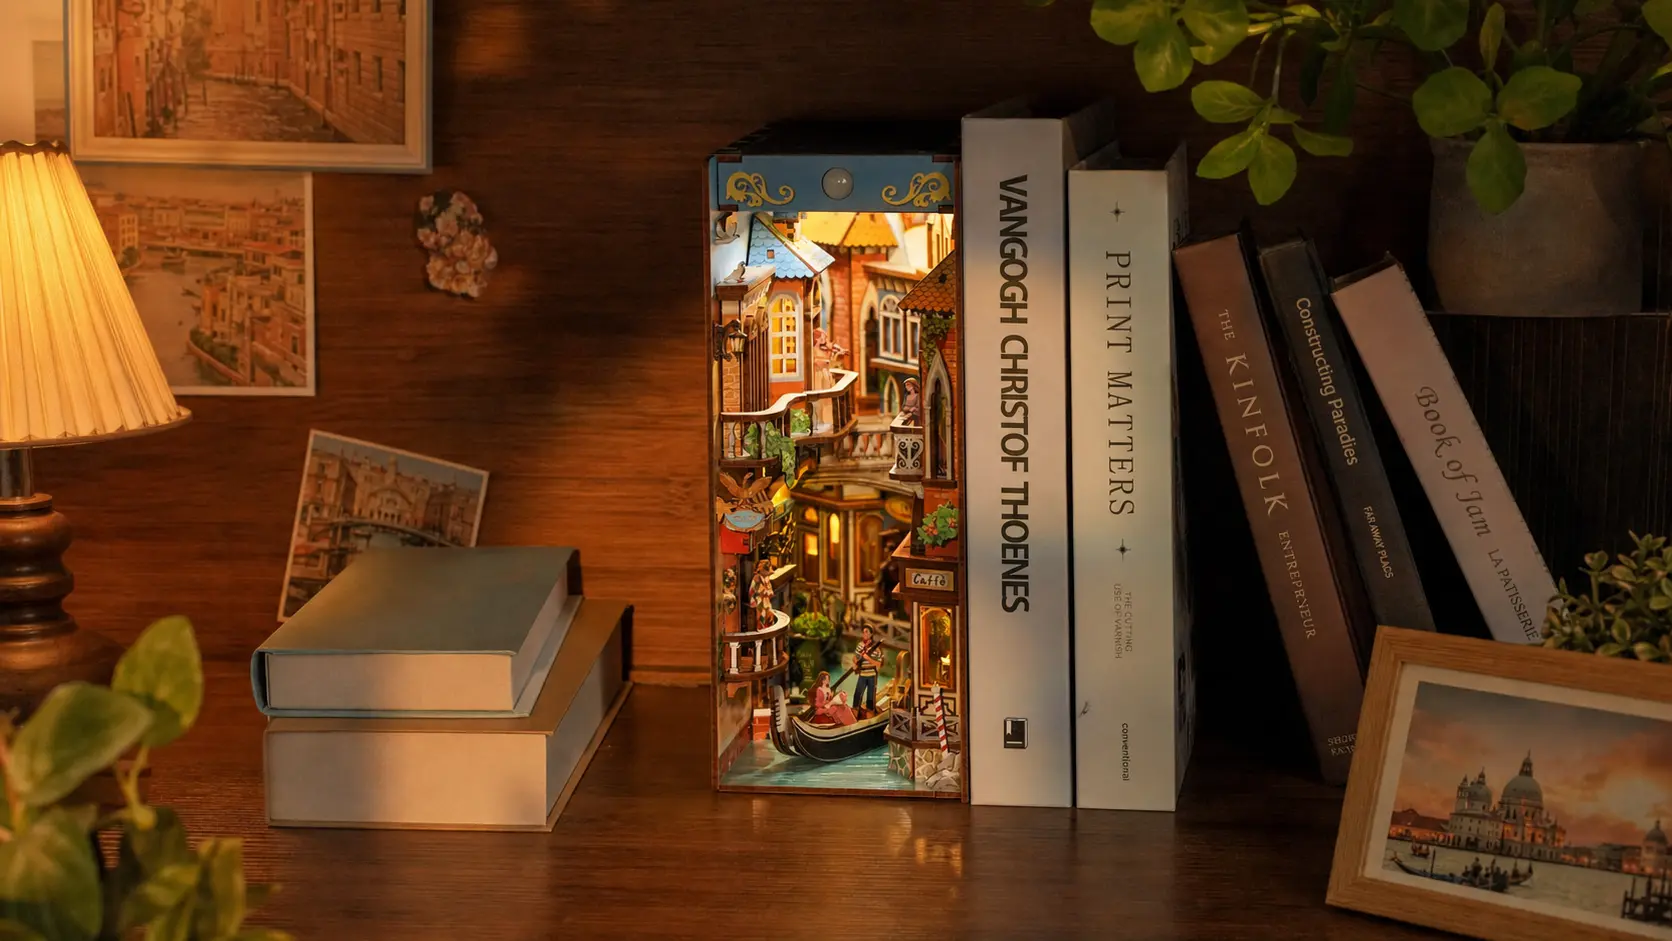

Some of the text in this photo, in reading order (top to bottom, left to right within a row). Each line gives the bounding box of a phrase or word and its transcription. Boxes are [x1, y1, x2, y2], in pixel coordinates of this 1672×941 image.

[1218, 309, 1235, 341] THE
[999, 174, 1030, 613] VANGOGH CHRISTOF THOENES
[1106, 250, 1135, 515] PRINT MATTERS
[1225, 352, 1288, 516] KINFOLK
[1296, 297, 1358, 466] Constructing Paradies
[1363, 505, 1376, 524] FAR
[1368, 523, 1384, 549] AWAY
[1415, 386, 1539, 641] Book of Jam LA PATISSERIE
[1124, 592, 1133, 652] THE CUTTING
[1122, 723, 1131, 781] conventional
